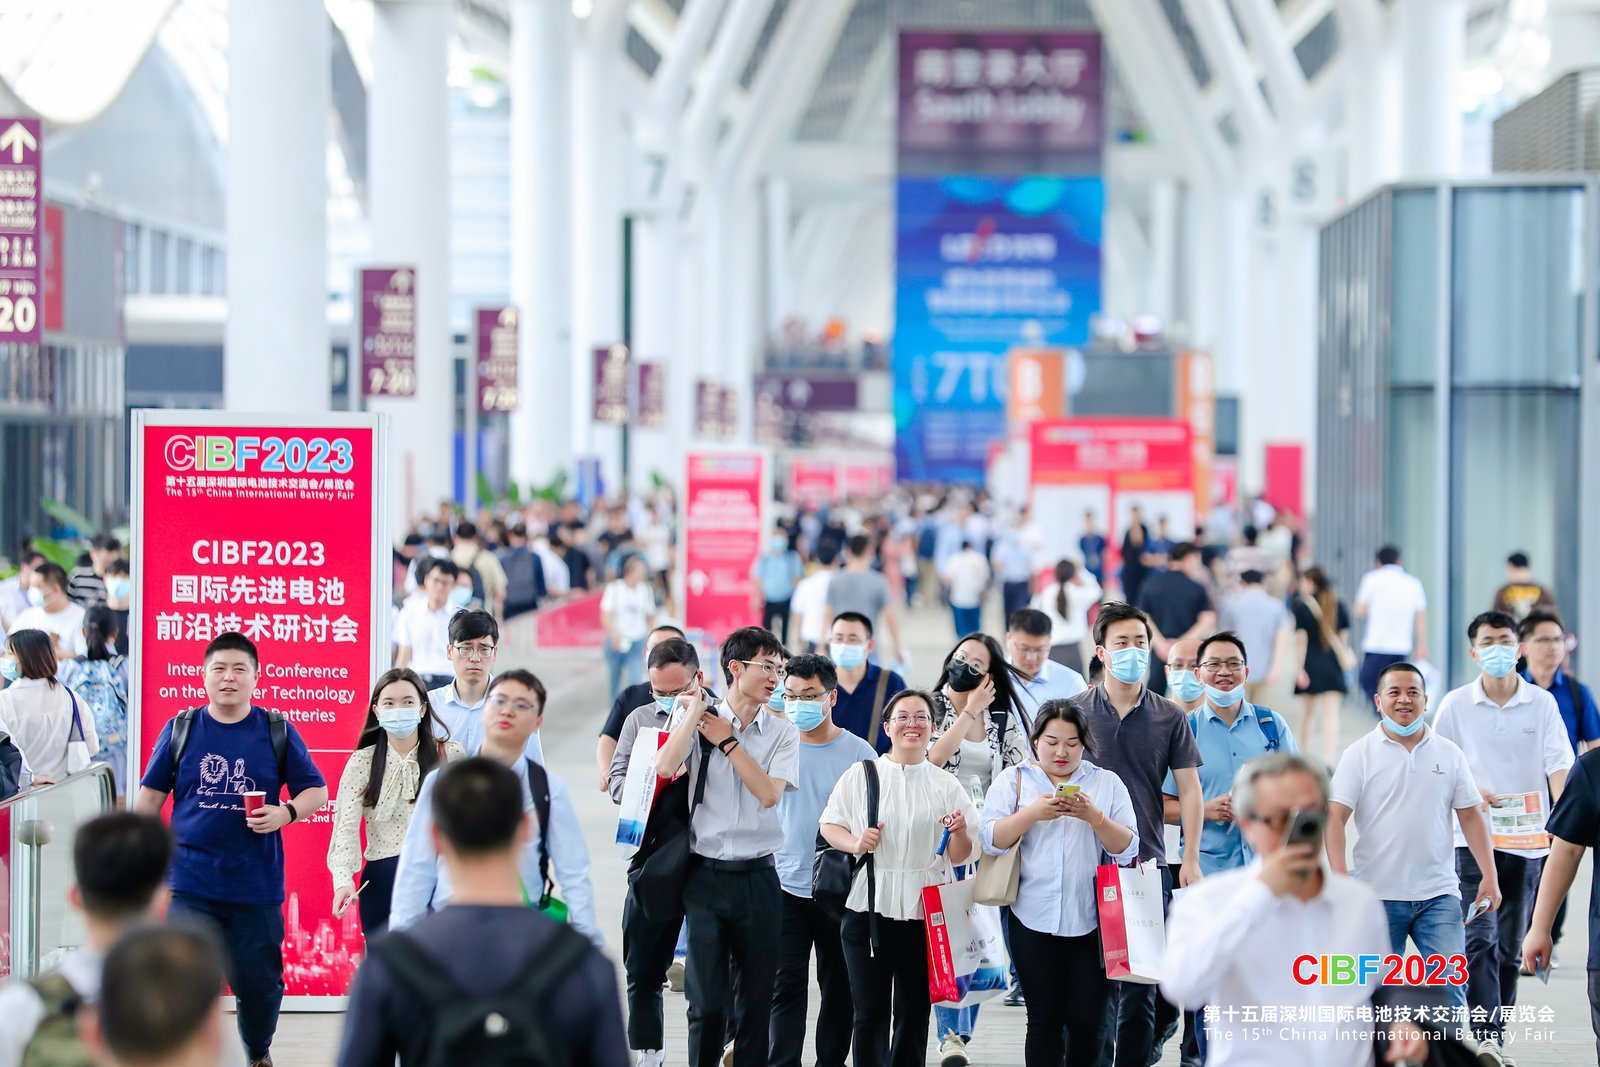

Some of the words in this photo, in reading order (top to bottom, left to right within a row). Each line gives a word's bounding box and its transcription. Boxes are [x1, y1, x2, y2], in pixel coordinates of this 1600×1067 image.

[164, 434, 354, 473] CIBF2023
[165, 487, 182, 497] The
[206, 488, 233, 498] China
[236, 489, 297, 499] International
[301, 490, 333, 501] Battery
[337, 492, 354, 500] Fair
[192, 539, 325, 567] CIBF2023
[171, 574, 345, 606] 国际先进电池
[156, 611, 359, 643] 前沿技术研讨会
[265, 663, 349, 678] Conference
[159, 686, 178, 698] on
[181, 683, 206, 698] the
[270, 685, 355, 704] Technology
[311, 813, 330, 823] 2nd
